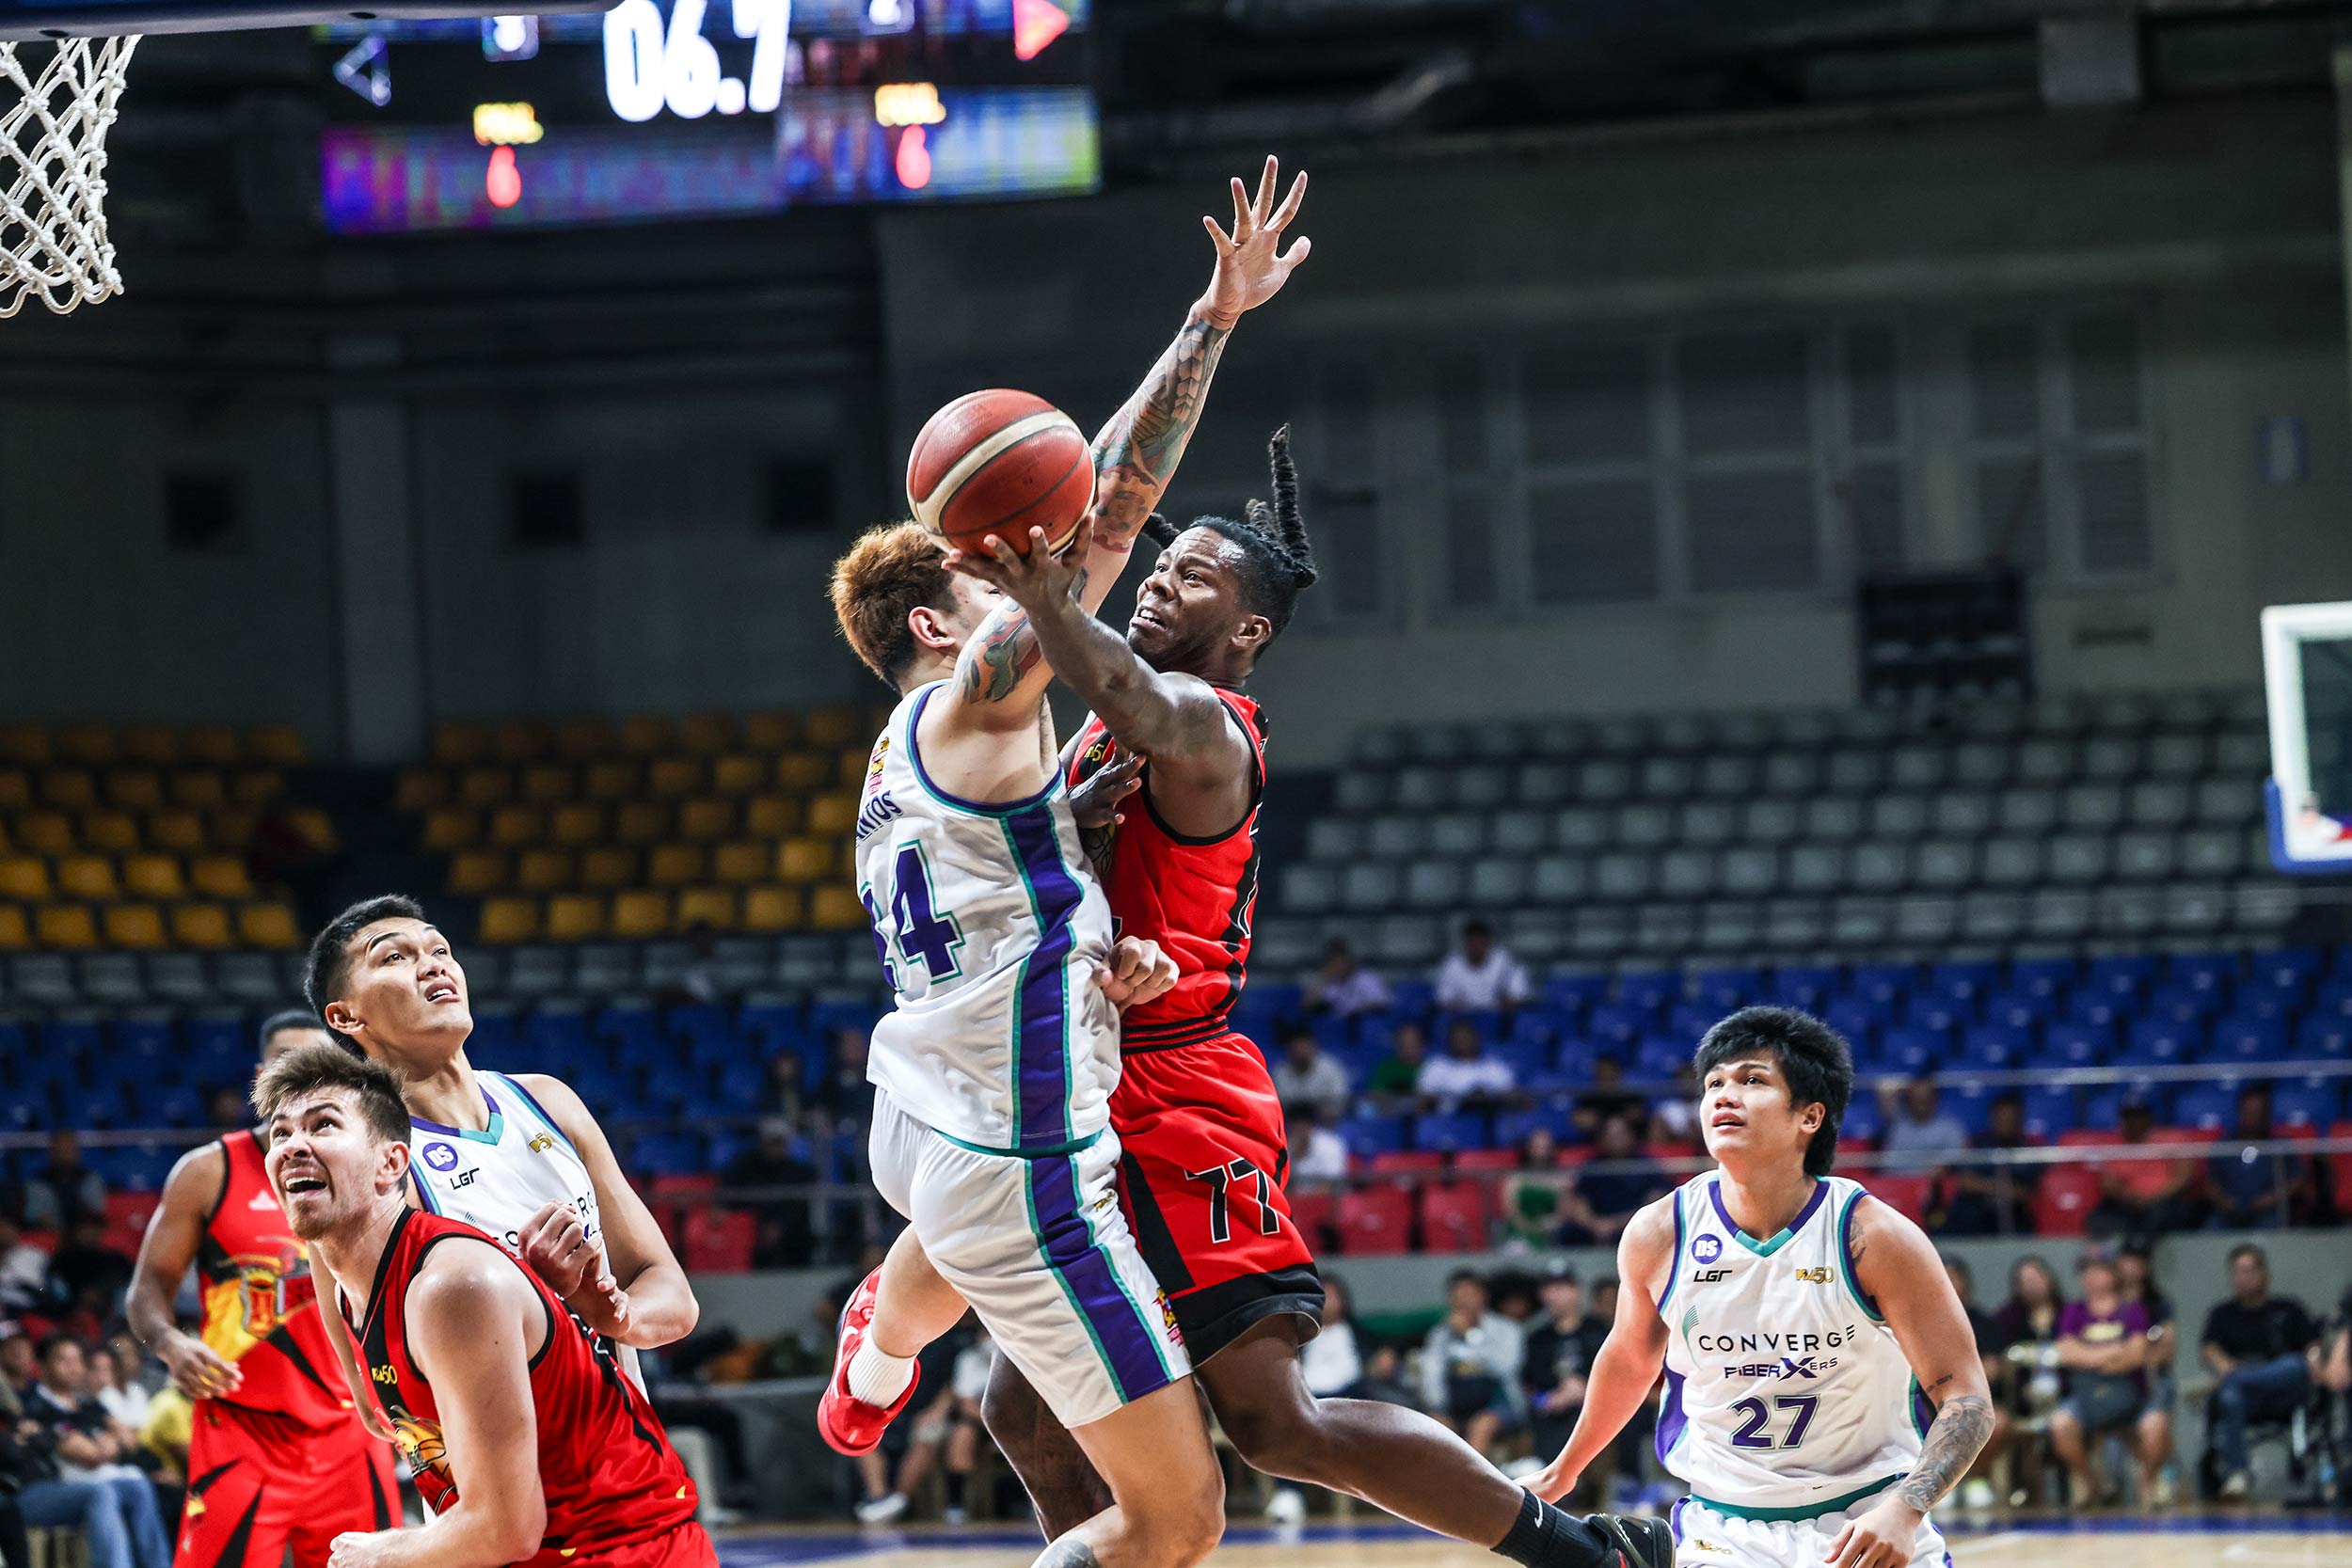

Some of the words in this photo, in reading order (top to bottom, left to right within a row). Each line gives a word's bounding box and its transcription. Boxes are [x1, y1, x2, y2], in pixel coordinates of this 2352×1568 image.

[602, 0, 791, 122] 06.7
[1184, 1157, 1280, 1244] 77
[1694, 1239, 1719, 1258] DS
[1698, 1323, 1855, 1353] CONVERGE
[1728, 1392, 1821, 1450] 27
